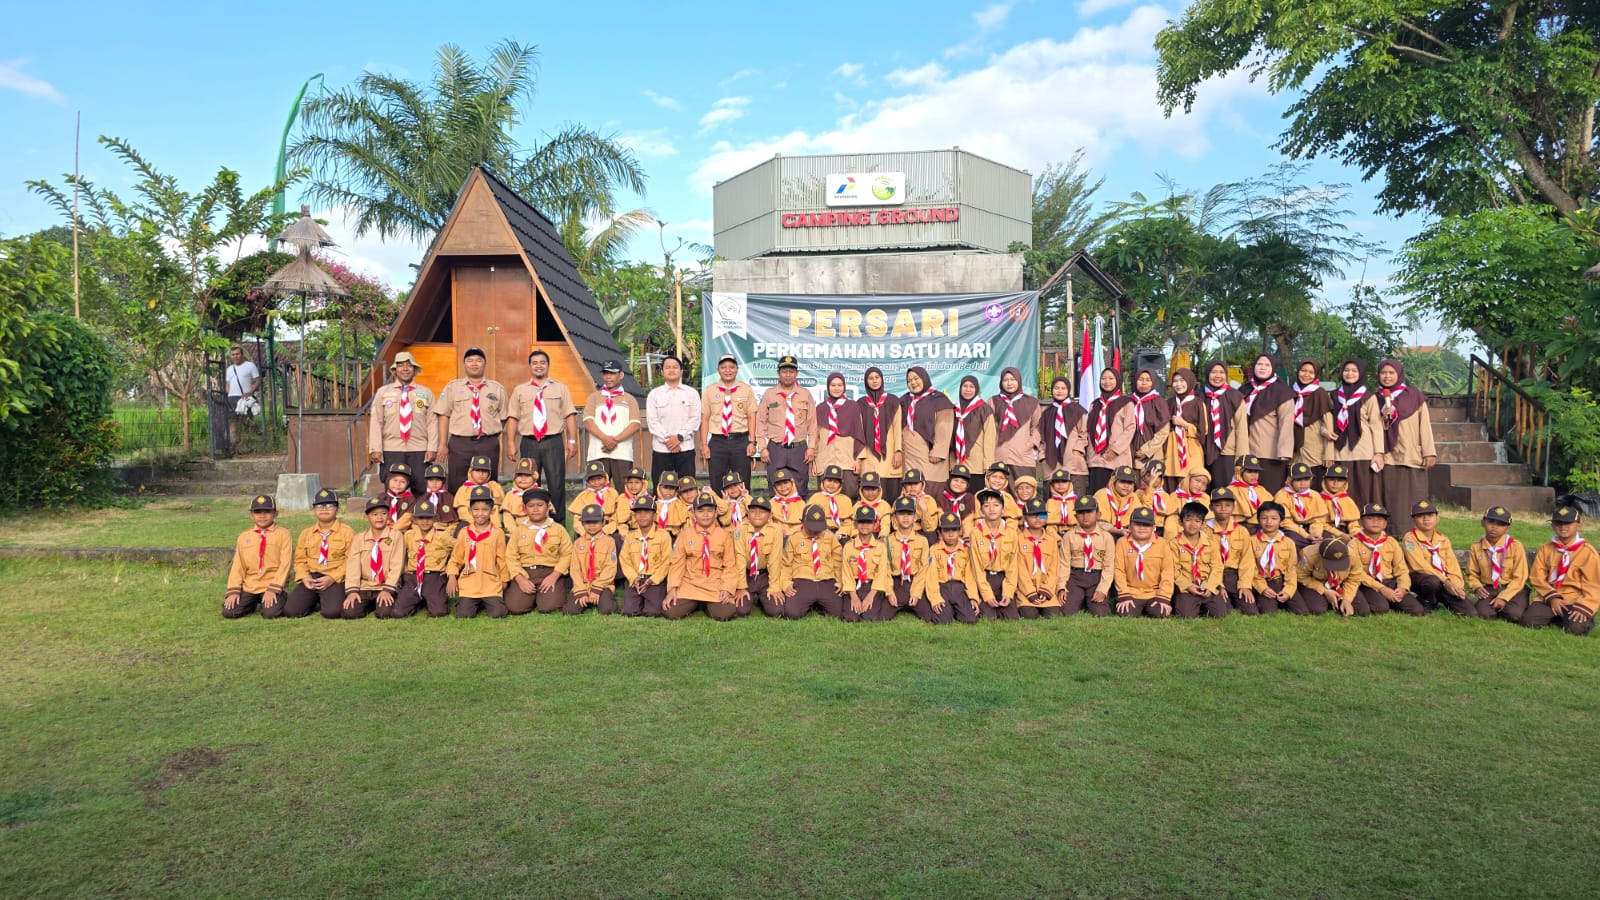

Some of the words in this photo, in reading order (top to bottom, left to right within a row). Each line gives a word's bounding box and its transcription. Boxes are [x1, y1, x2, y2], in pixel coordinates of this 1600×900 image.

[782, 212, 871, 228] CAMPING
[877, 207, 960, 225] GROUND
[788, 308, 959, 337] PERSARI
[753, 342, 885, 359] PERKEMAHAN
[889, 342, 941, 358] SATU
[945, 342, 991, 358] HARI
